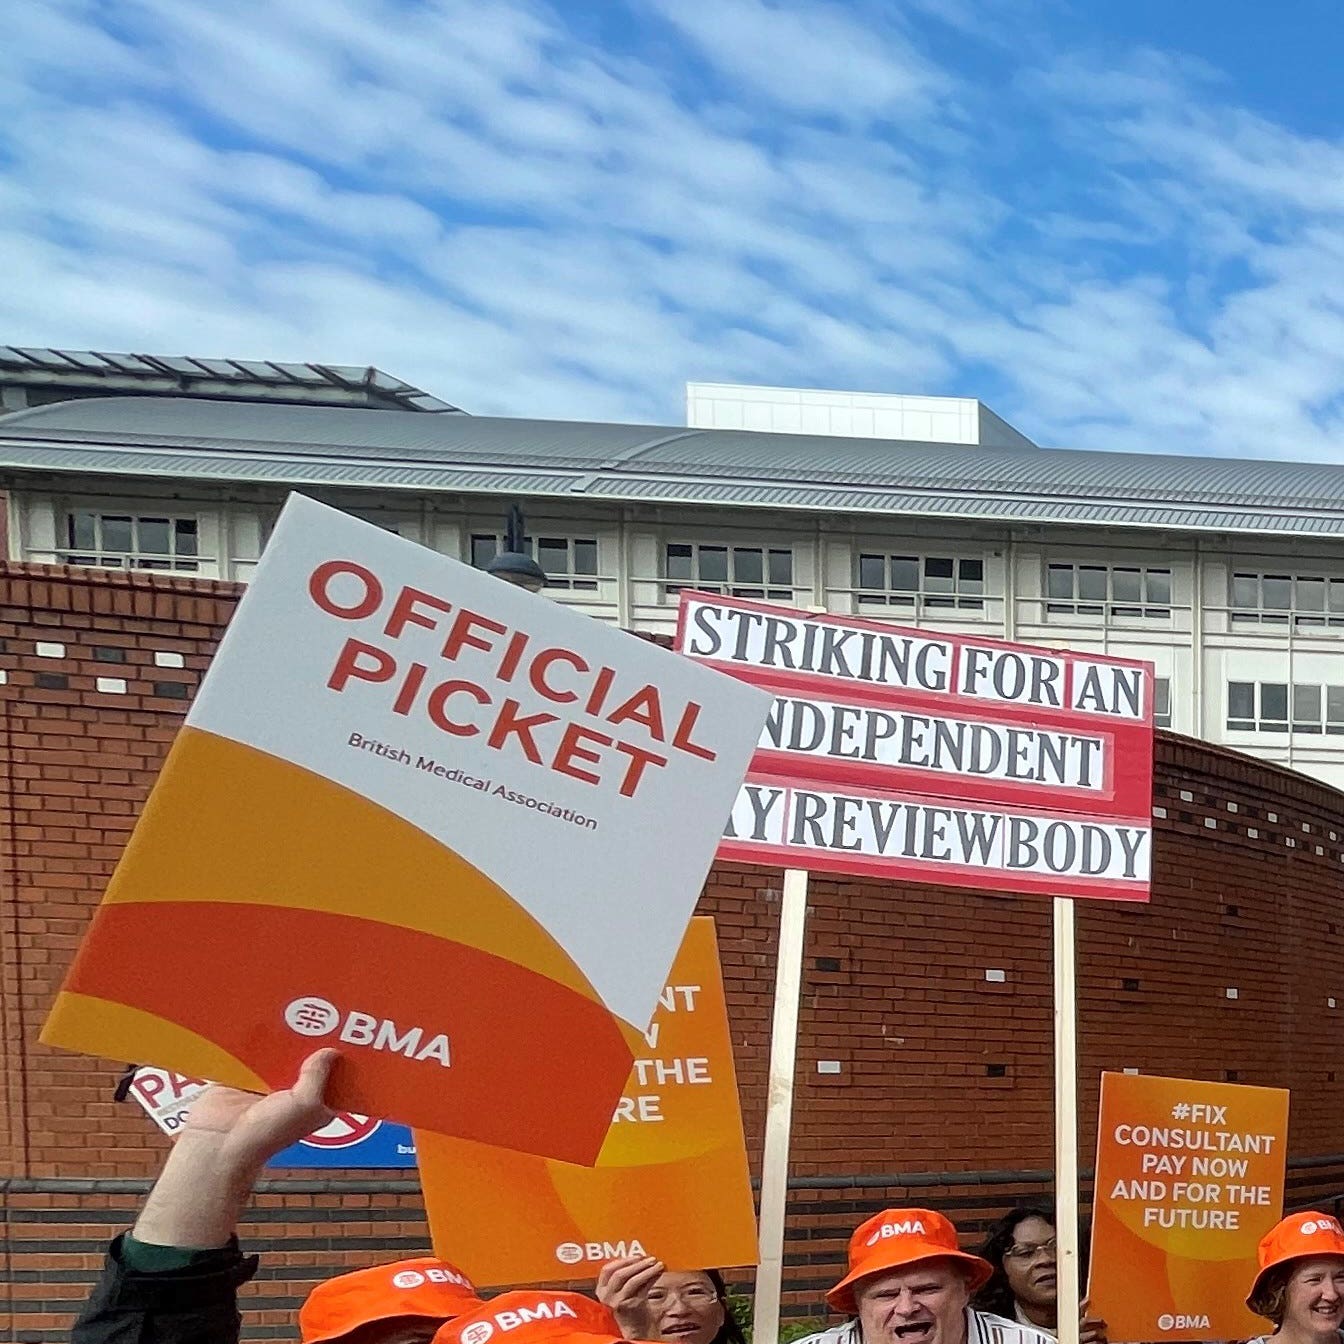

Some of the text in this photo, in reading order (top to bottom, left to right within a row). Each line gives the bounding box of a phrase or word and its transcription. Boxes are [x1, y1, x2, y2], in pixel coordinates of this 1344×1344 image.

[309, 560, 716, 762] OFFICIAL
[690, 605, 1143, 719] STRIKING FOR AN
[327, 637, 667, 798] PICKET
[762, 697, 1101, 790] NDEPENDENT
[347, 731, 599, 831] British Medical Association
[790, 792, 1004, 865] REVIEW
[1006, 818, 1147, 880] BODY
[339, 1010, 451, 1068] BMA
[634, 1057, 713, 1086] THE
[133, 1072, 208, 1109] PA
[1171, 1103, 1228, 1126] #FIX
[1115, 1124, 1275, 1156] CONSULTANT
[1142, 1153, 1249, 1179] PAY NOW
[1110, 1179, 1271, 1206] AND FOR THE
[881, 1219, 926, 1239] BMA
[1143, 1208, 1240, 1231] FUTURE
[585, 1239, 648, 1261] BMA
[493, 1300, 577, 1333] BMA
[1176, 1315, 1210, 1331] BMA
